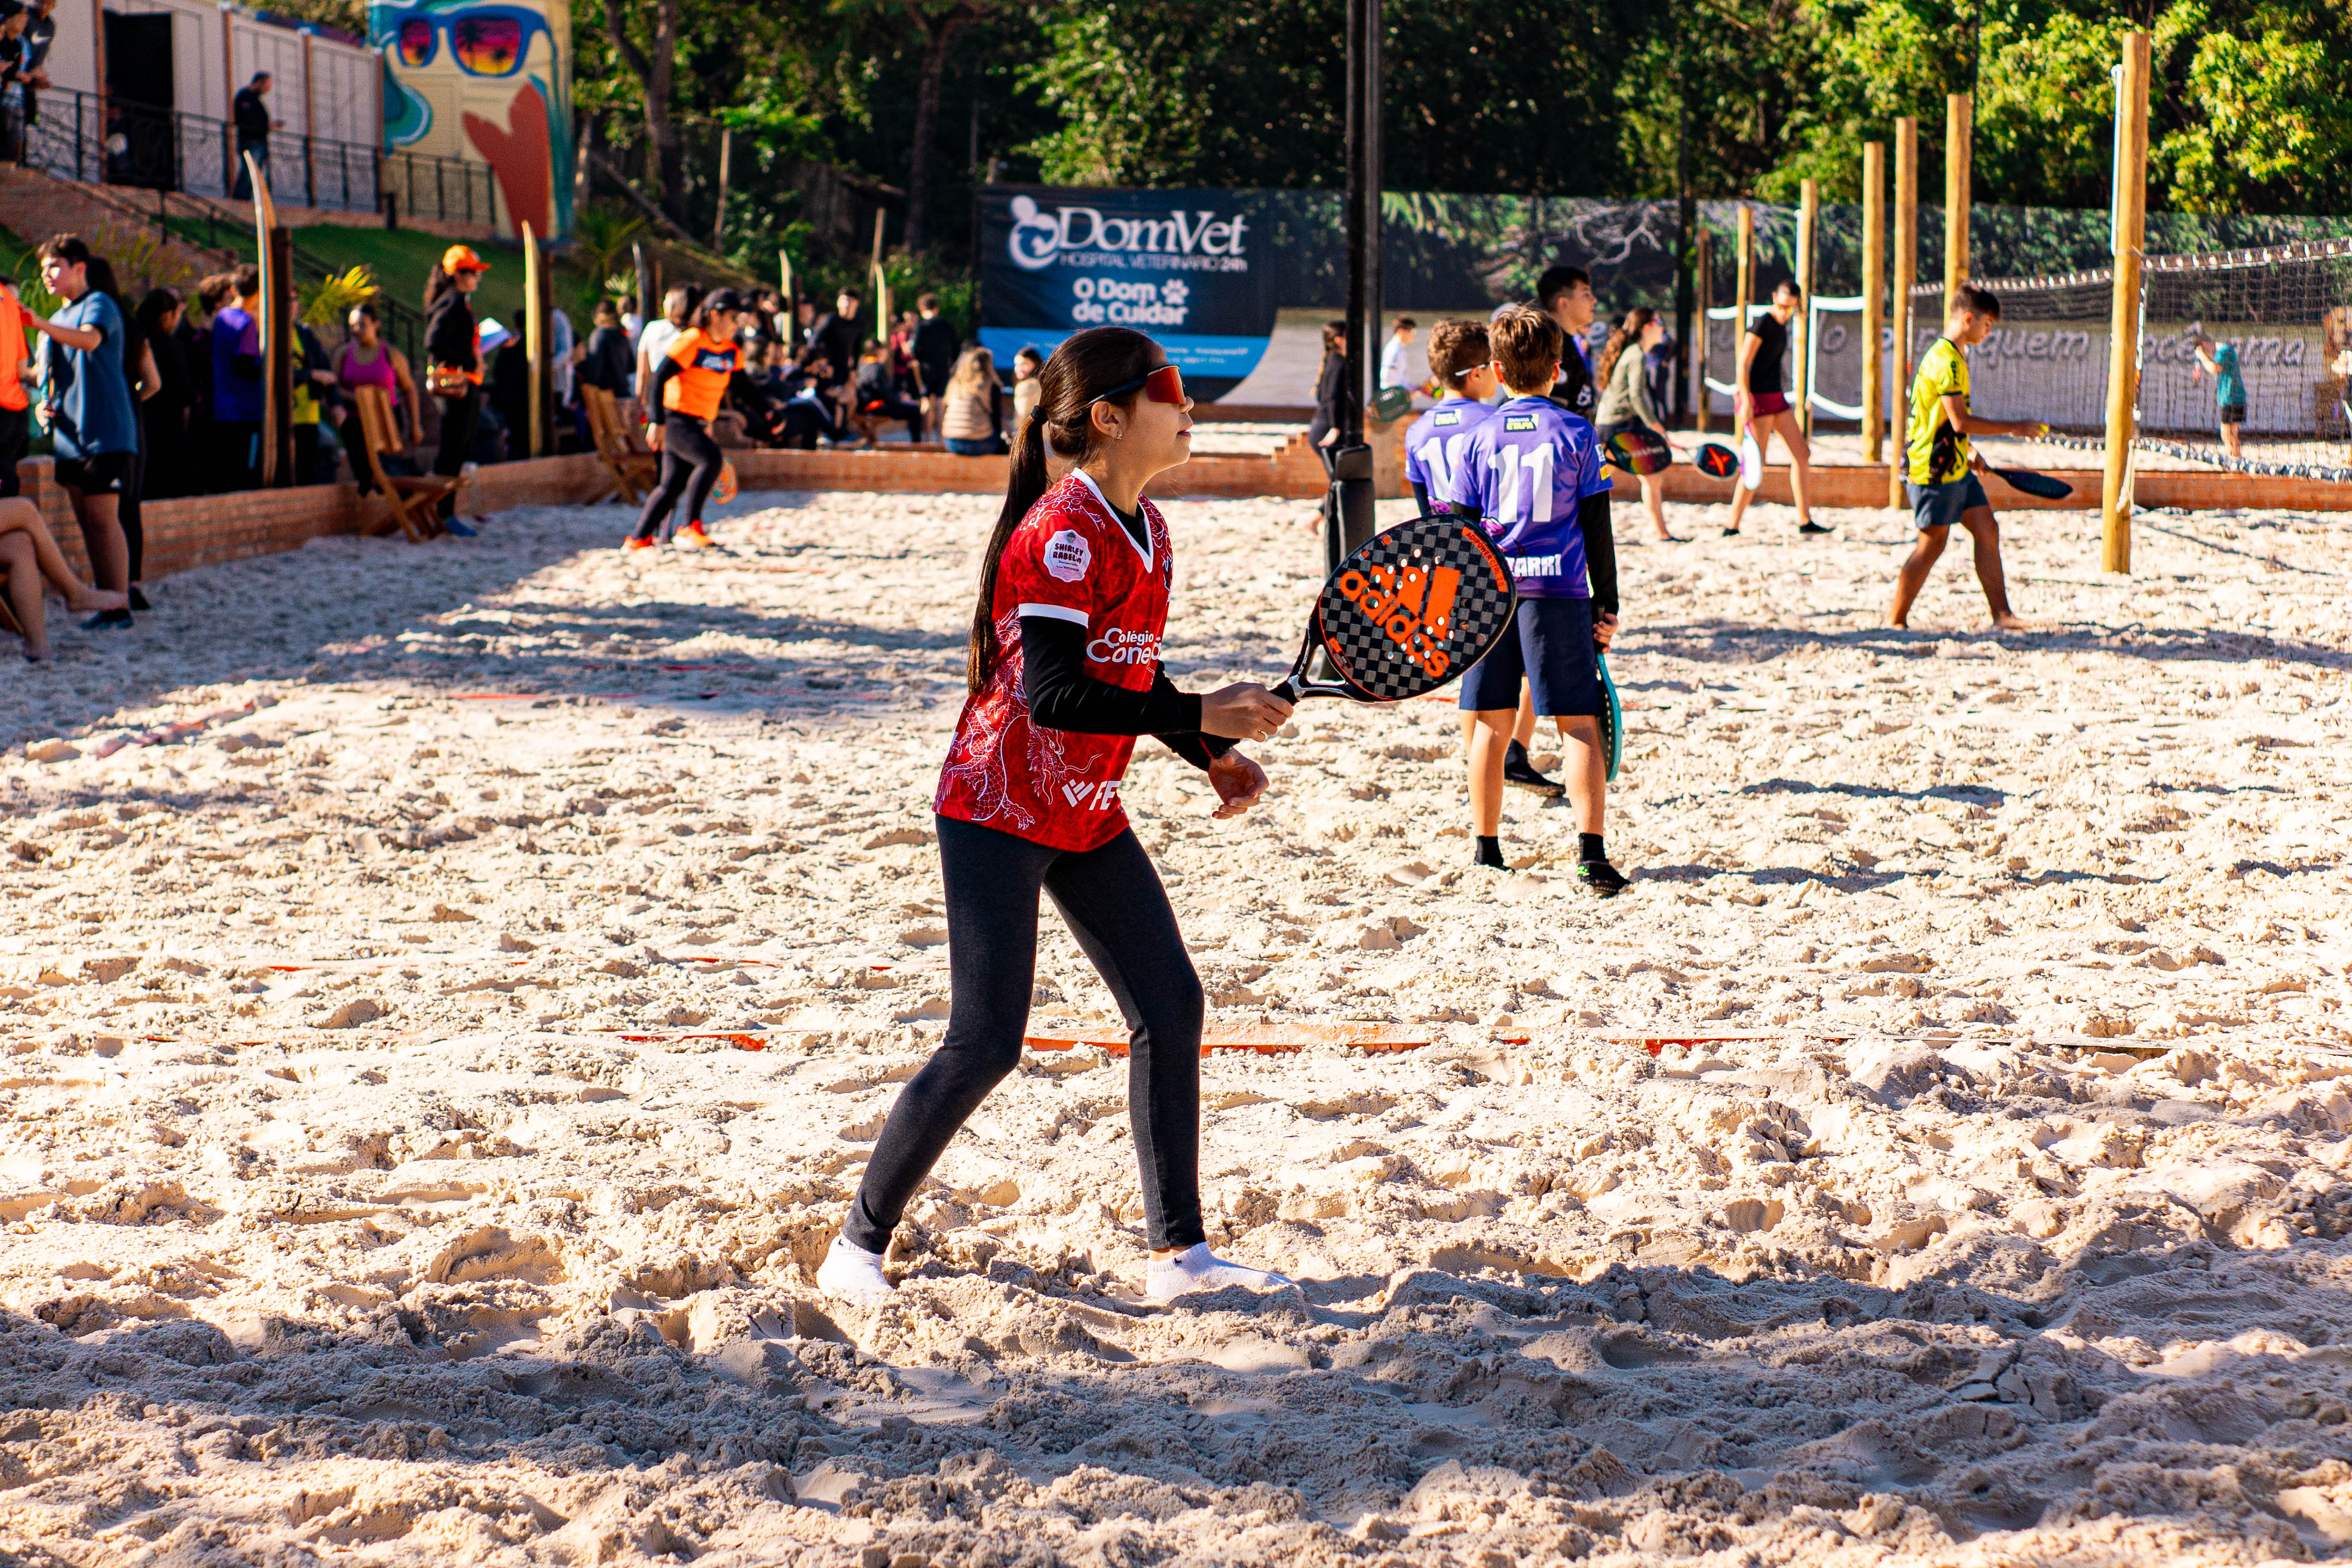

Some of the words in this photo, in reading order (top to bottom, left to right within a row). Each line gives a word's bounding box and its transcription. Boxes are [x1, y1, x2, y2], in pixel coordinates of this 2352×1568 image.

[1056, 206, 1250, 255] DomVet
[1059, 252, 1128, 268] HOSPITAL
[1220, 256, 1248, 272] 24h
[1073, 277, 1095, 299] O
[1098, 278, 1156, 301] Dom
[1072, 300, 1105, 321] de
[1107, 301, 1189, 324] Cuidar
[1487, 443, 1553, 525] 11
[1055, 543, 1084, 556] SHIRLEY
[1466, 532, 1492, 559] ADIPOWER
[1340, 571, 1450, 678] adidas
[1105, 627, 1154, 648] Colégio
